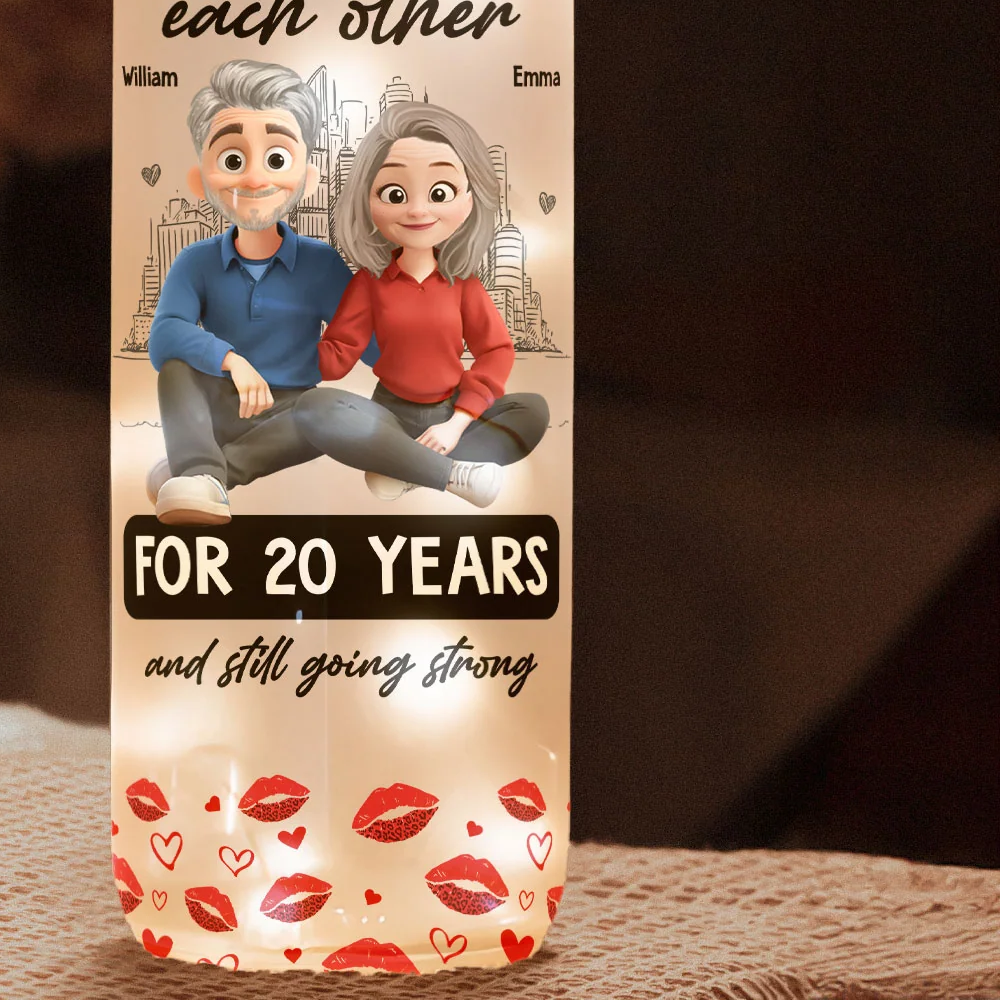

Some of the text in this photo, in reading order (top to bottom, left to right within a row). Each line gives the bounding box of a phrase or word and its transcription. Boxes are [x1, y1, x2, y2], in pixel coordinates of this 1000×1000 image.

[121, 65, 179, 88] William
[513, 65, 561, 88] Emma
[135, 534, 548, 596] FOR 20 YEARS
[144, 635, 538, 698] and still going strong
